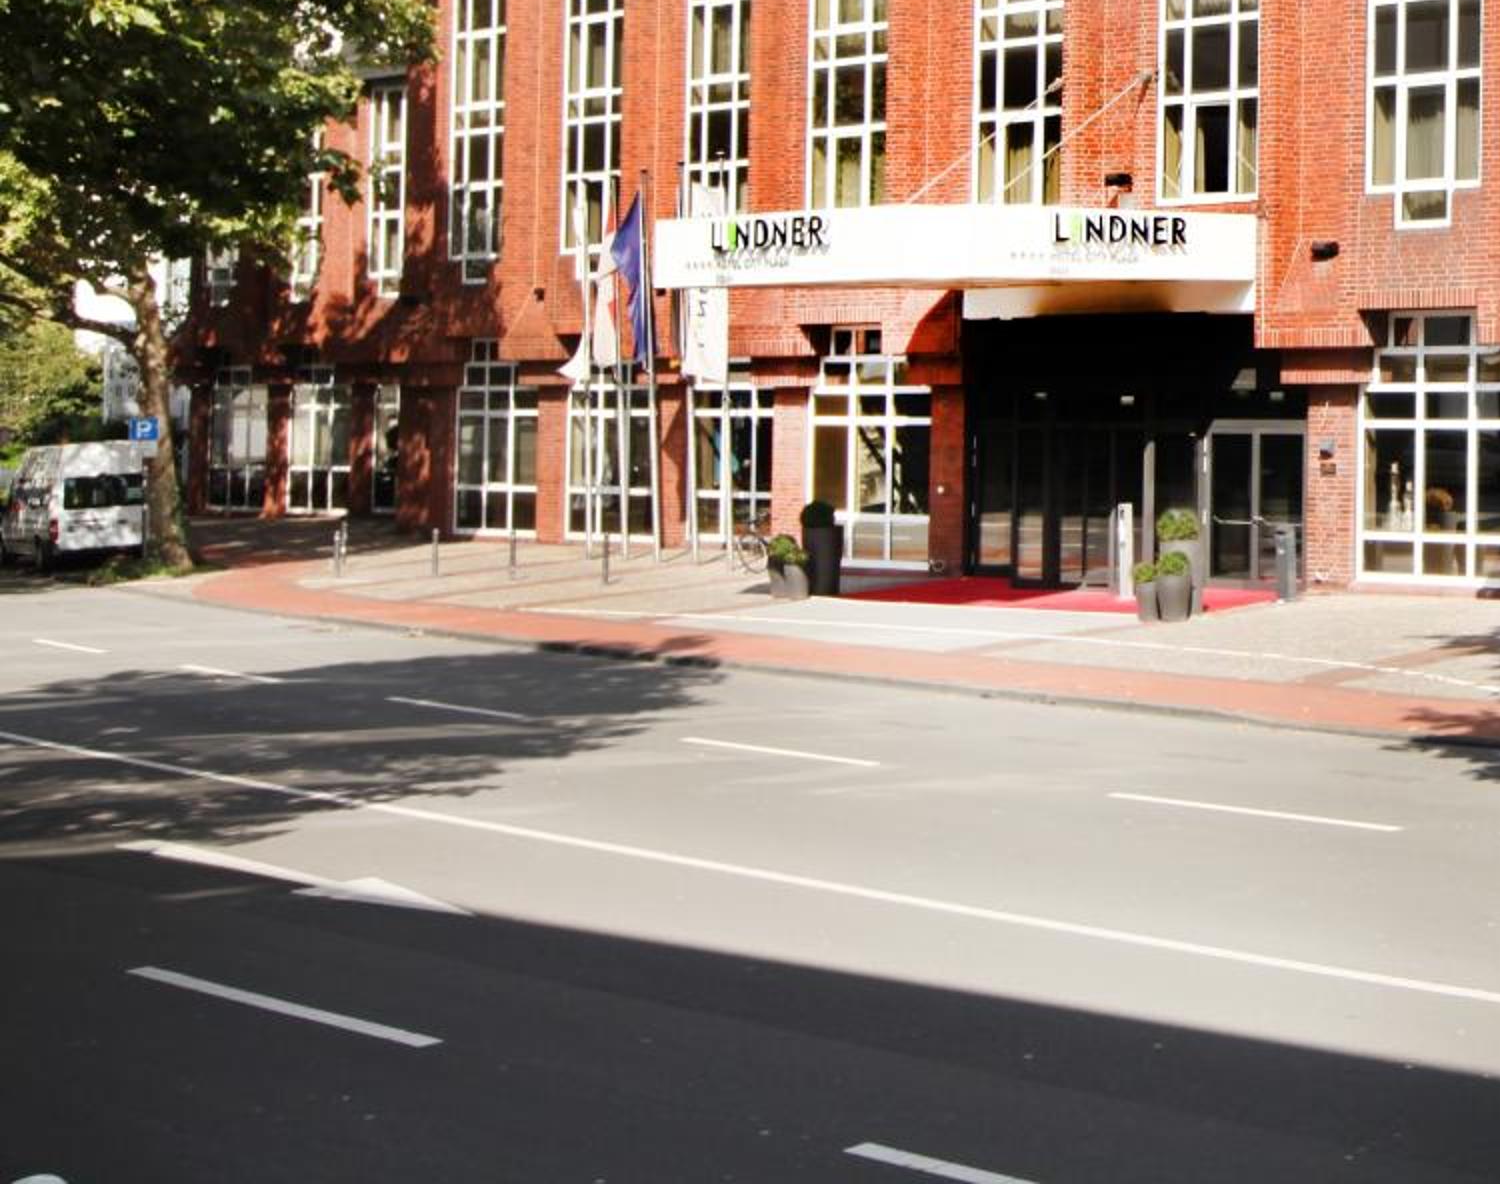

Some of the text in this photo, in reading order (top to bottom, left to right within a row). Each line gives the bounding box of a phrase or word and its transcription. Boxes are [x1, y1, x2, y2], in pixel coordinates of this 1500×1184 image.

[711, 216, 823, 250] LINDNER
[1055, 213, 1187, 245] LINDNER
[137, 420, 152, 437] P
